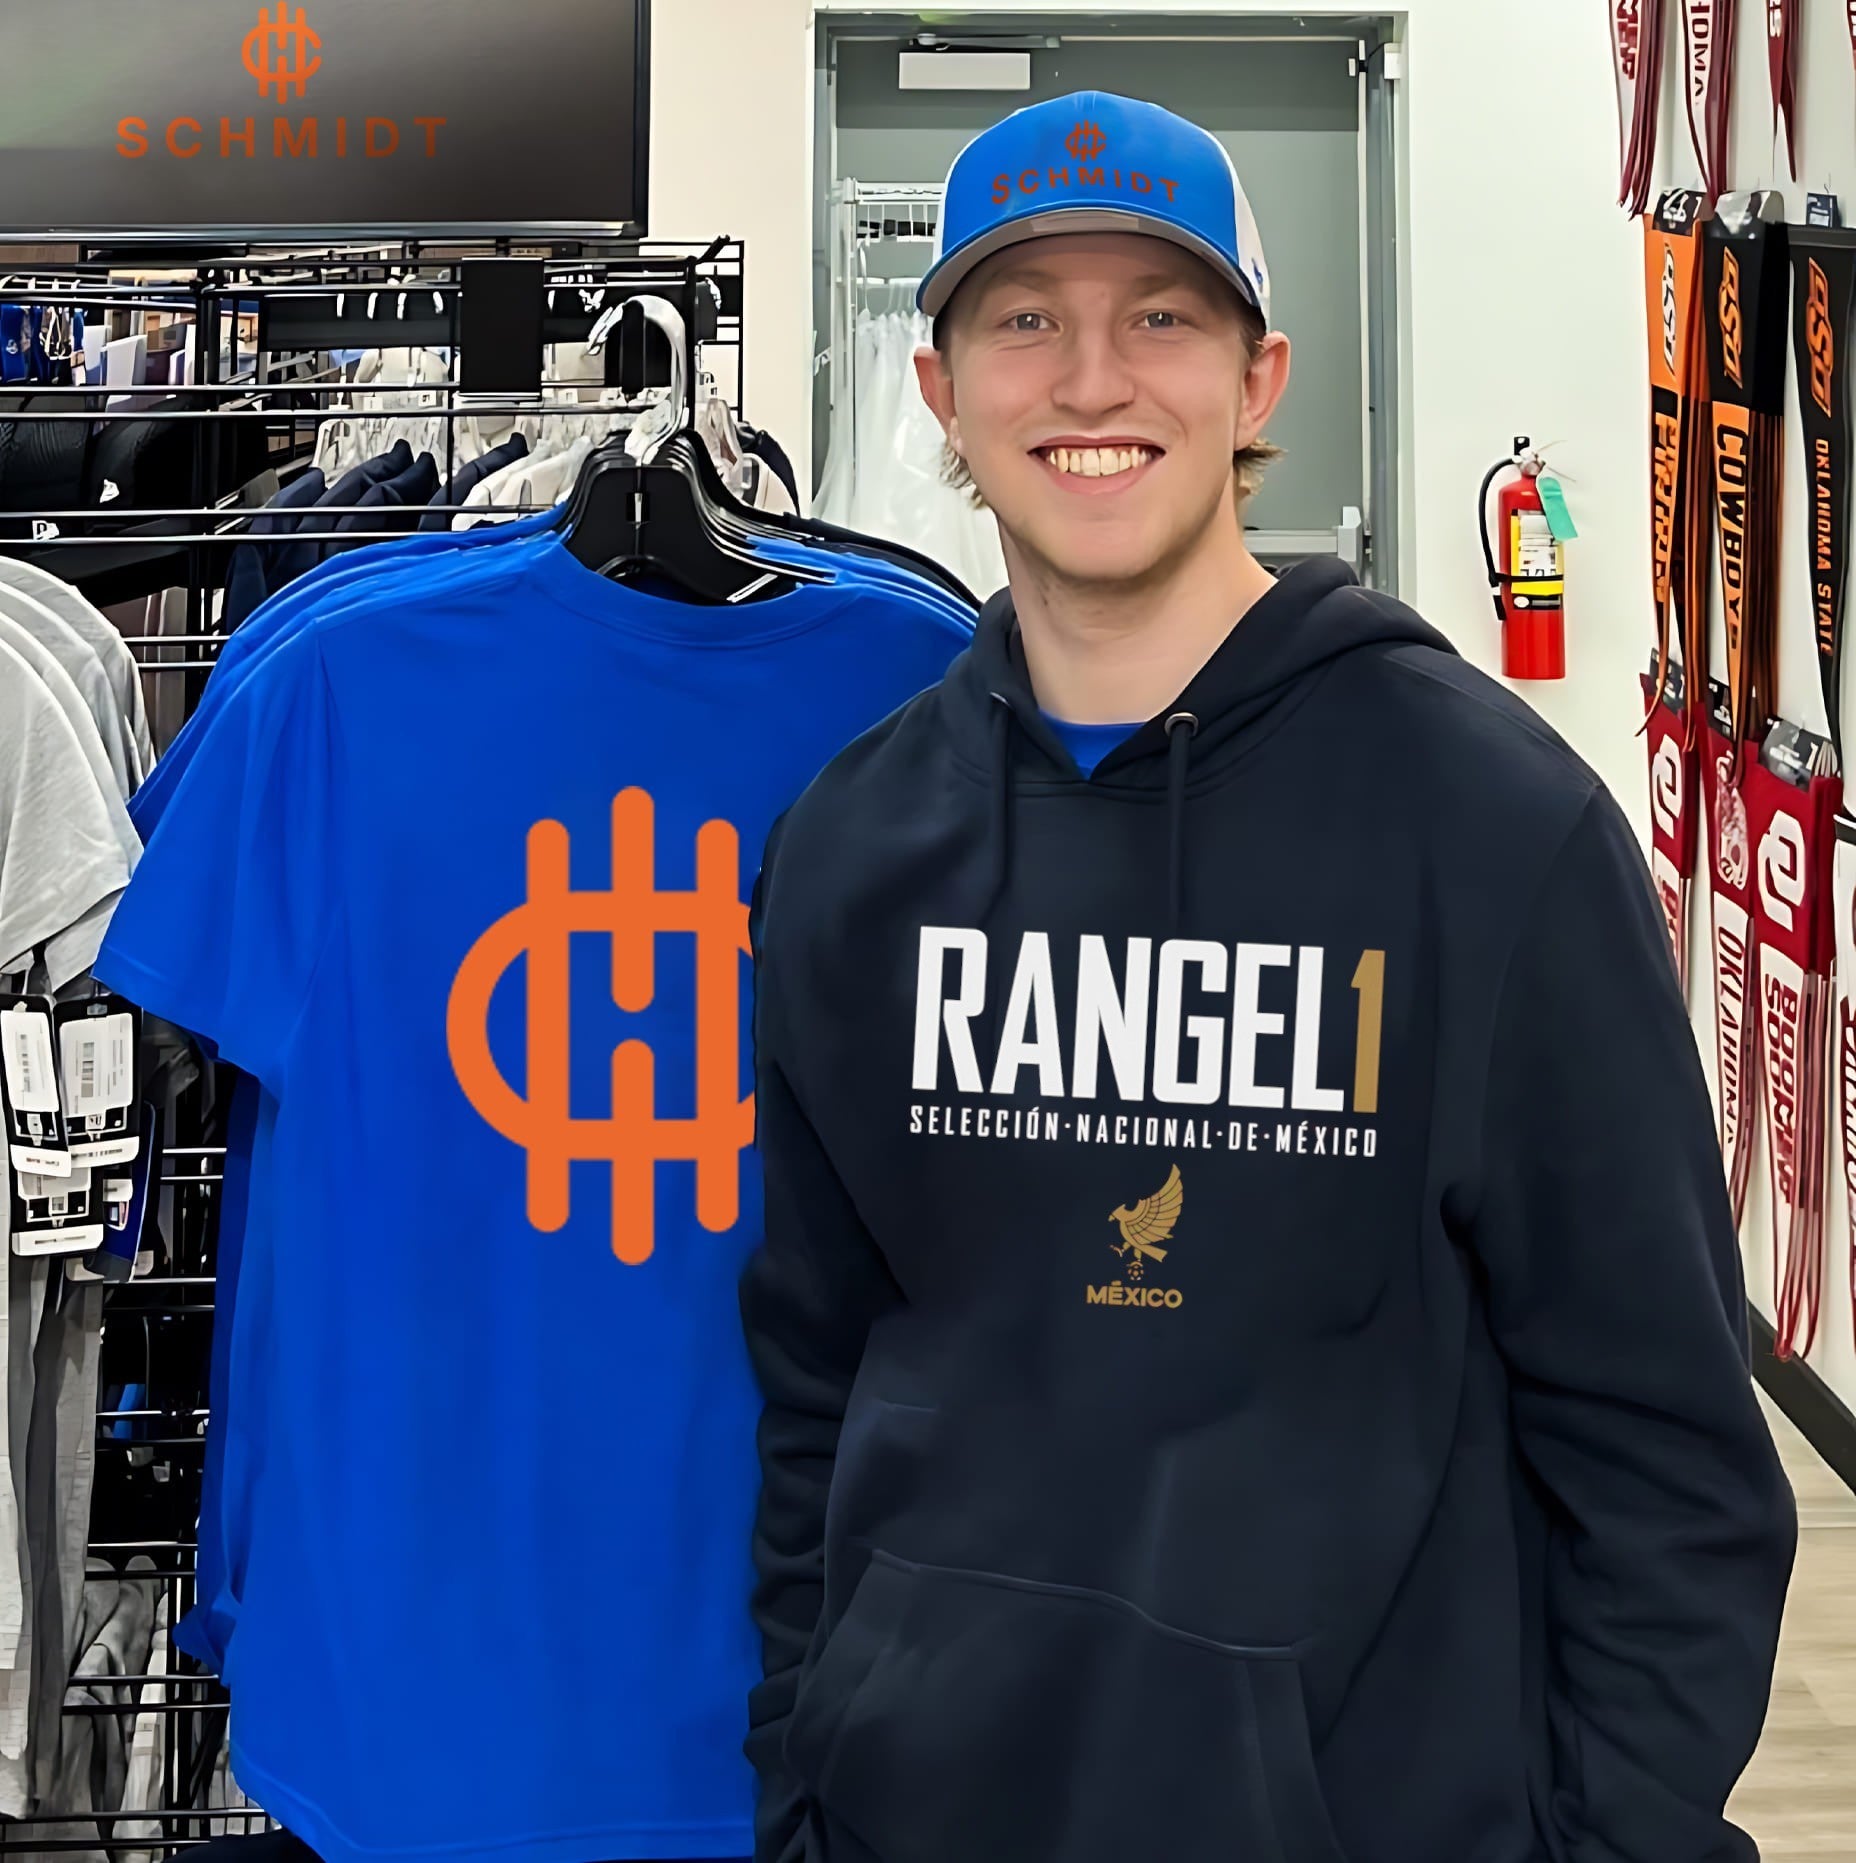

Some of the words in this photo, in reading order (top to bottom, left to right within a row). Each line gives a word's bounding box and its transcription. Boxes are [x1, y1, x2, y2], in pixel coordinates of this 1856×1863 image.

[115, 116, 448, 159] SCHMIDT
[991, 166, 1180, 205] SCHMIDT
[1815, 438, 1832, 570] OKLAHOMA
[911, 925, 1345, 1112] RANGEL
[1086, 1280, 1183, 1309] MÉXICO
